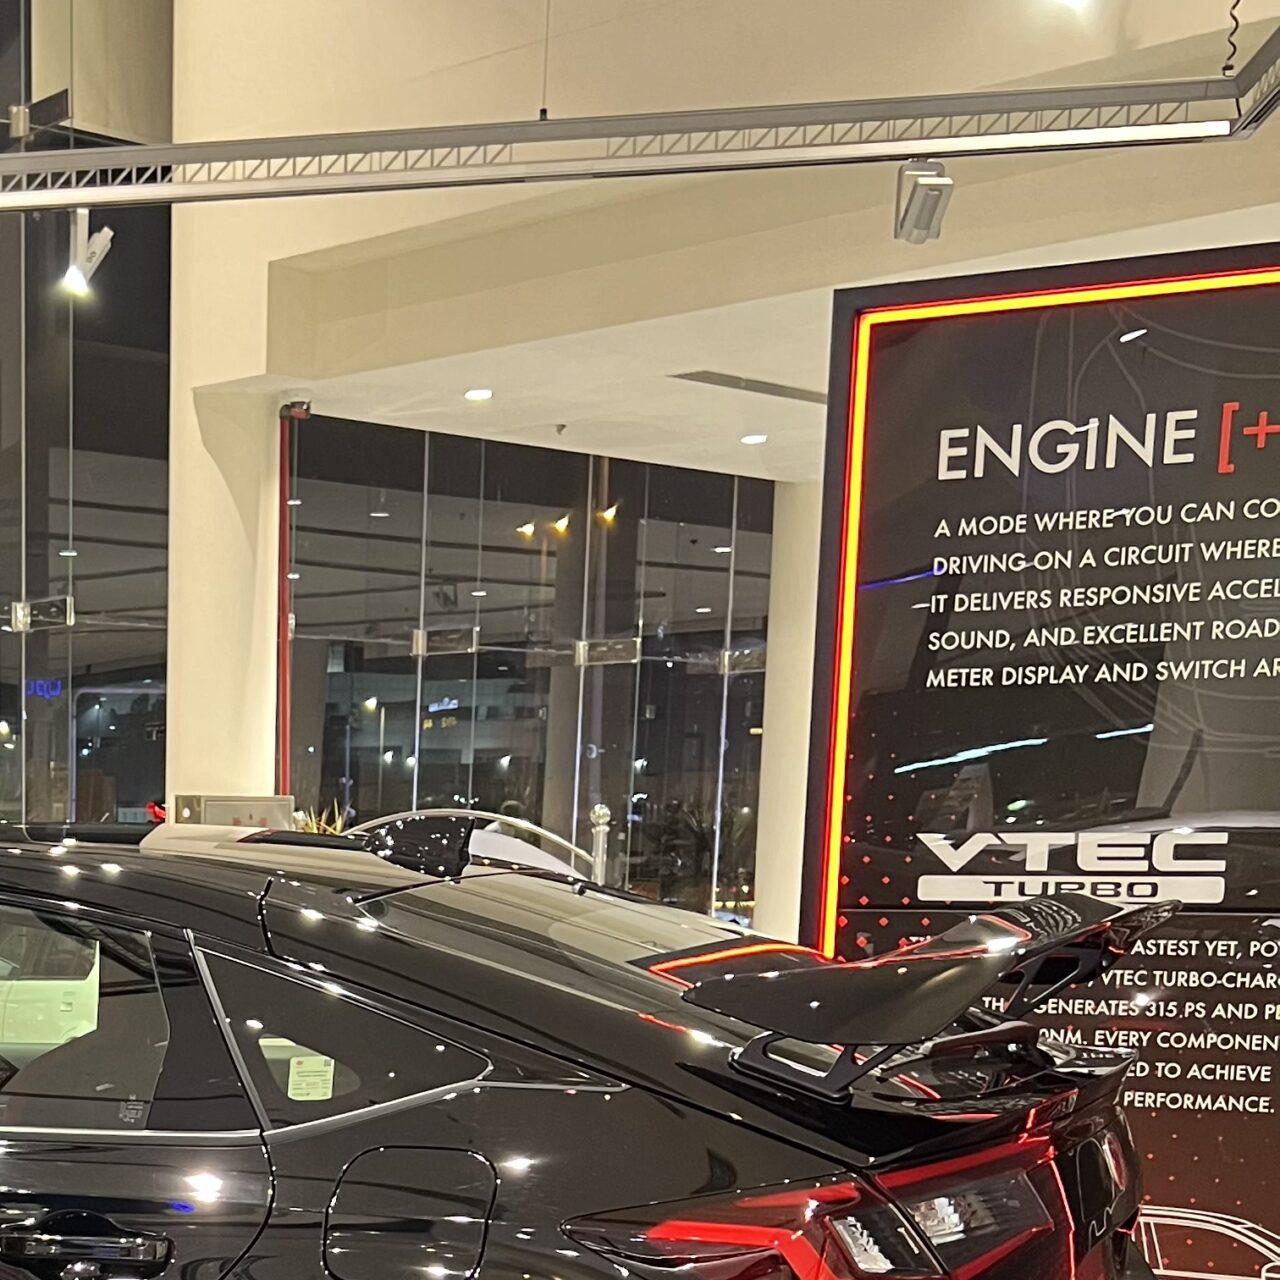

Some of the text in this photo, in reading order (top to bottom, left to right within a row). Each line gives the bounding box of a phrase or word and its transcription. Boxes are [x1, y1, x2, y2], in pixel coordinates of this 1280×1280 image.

[937, 409, 1198, 481] ENGINE
[933, 518, 951, 538] A
[957, 513, 1027, 537] MODE
[1034, 508, 1115, 532] WHERE
[1123, 505, 1173, 528] YOU
[1180, 500, 1235, 524] CAN
[933, 537, 1280, 576] DRIVING ON A CIRCUIT WHERE
[930, 594, 948, 613] IT
[953, 589, 1052, 613] DELIVERS
[1059, 581, 1202, 608] RESPONSIVE
[928, 618, 1280, 651] SOUND, AND EXCELLENT ROAD
[926, 667, 994, 688] METER
[1001, 664, 1089, 686] DISPLAY
[1094, 662, 1148, 683] AND
[1155, 658, 1246, 681] SWITCH
[916, 831, 1229, 872] VTEC
[1130, 939, 1280, 960] ASTEST YET, PO
[1101, 969, 1280, 989] VTEC TURBO-CHAR
[1211, 1003, 1258, 1020] AND
[1094, 1029, 1152, 1047] EVERY
[1156, 1030, 1280, 1051] COMPONEN
[1155, 1062, 1181, 1078] TO
[1186, 1063, 1272, 1082] ACHIEVE
[1123, 1091, 1275, 1114] PERFORMANCE.
